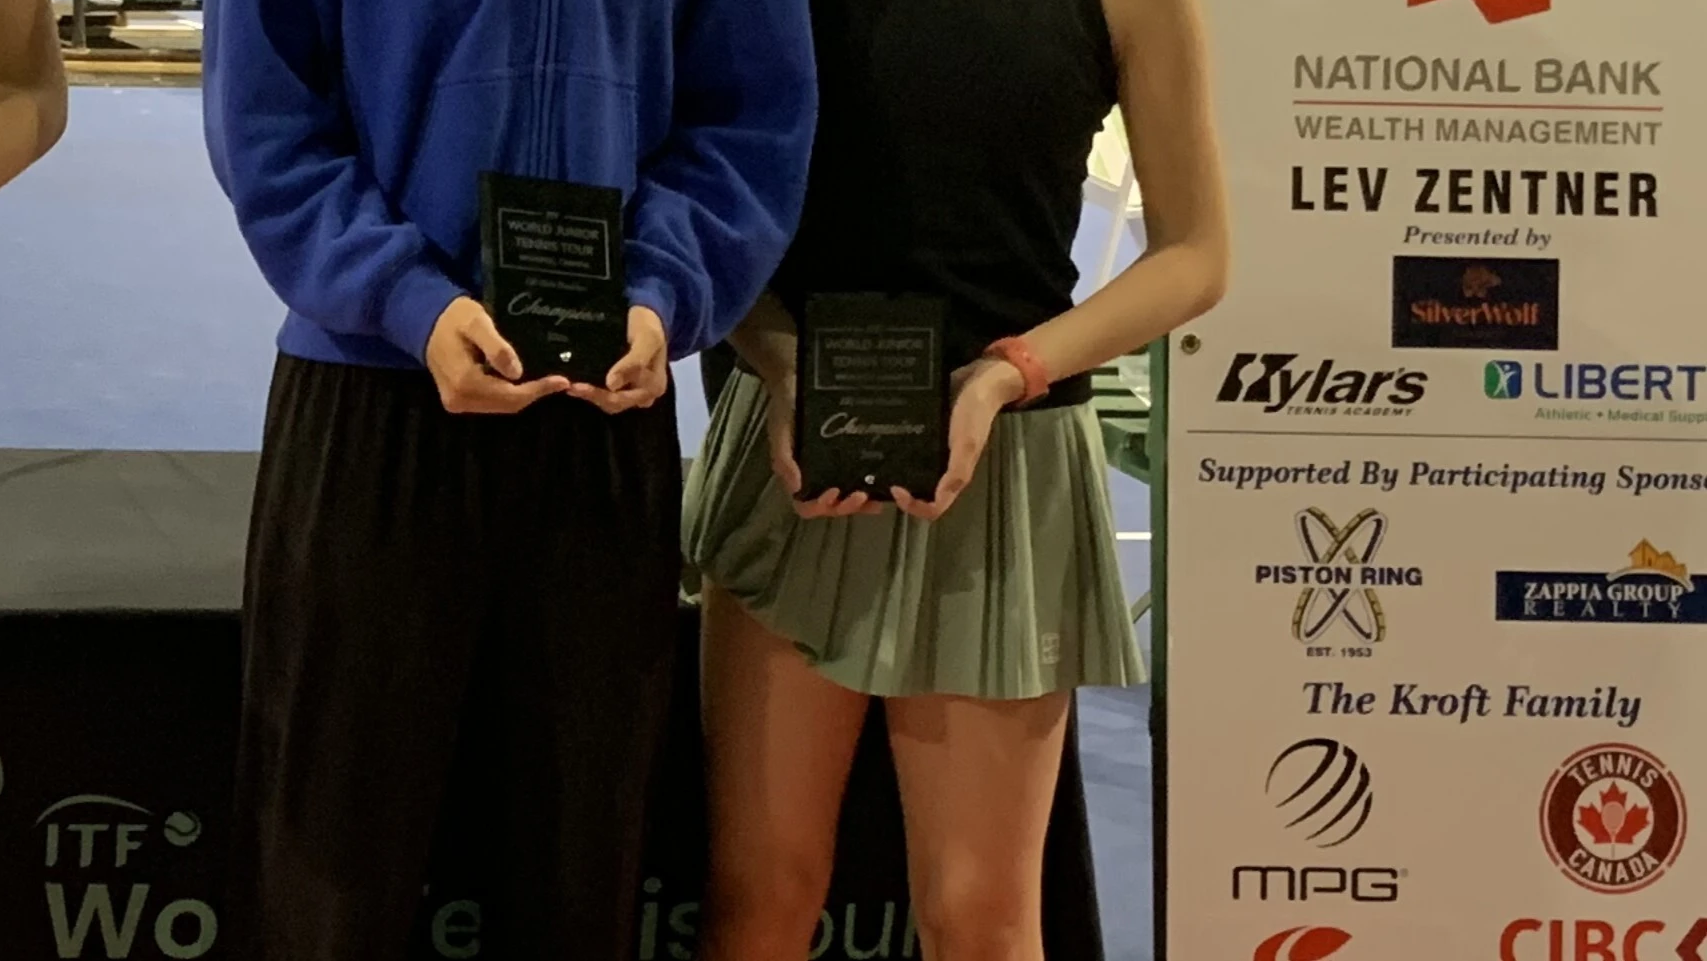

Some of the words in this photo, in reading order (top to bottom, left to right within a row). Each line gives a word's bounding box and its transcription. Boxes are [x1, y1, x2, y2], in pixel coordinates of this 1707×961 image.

[1293, 54, 1521, 94] NATIONAL
[1534, 58, 1661, 96] BANK
[1294, 115, 1424, 141] WEALTH
[1435, 118, 1663, 146] MANAGEMENT
[1291, 166, 1388, 212] LEV
[1414, 168, 1659, 218] ZENTNER
[1403, 225, 1519, 247] Presented
[1524, 228, 1553, 251] by
[1410, 299, 1542, 327] SilverWolf
[1287, 405, 1338, 417] TENNIS
[1343, 407, 1413, 418] ACADEMY
[1534, 407, 1592, 421] Athletic
[1607, 409, 1664, 422] Medical
[1198, 458, 1351, 491] Supported
[1361, 461, 1399, 491] By
[1409, 461, 1606, 496] Participating
[1254, 565, 1352, 586] PISTON
[1360, 566, 1424, 587] RING
[1524, 581, 1603, 601] ZAPPIA
[1606, 584, 1684, 602] GROUP
[1523, 600, 1682, 619] REALTY
[1305, 646, 1336, 658] EST.
[1340, 646, 1373, 658] 1953
[1302, 681, 1376, 715] The
[1388, 683, 1492, 724] Kroft
[1503, 685, 1642, 728] Family
[1566, 751, 1659, 790] TENNIS
[45, 823, 149, 869] ITF
[1566, 847, 1660, 886] CANADA
[1232, 866, 1399, 903] MPG
[1500, 917, 1667, 961] CIBC
